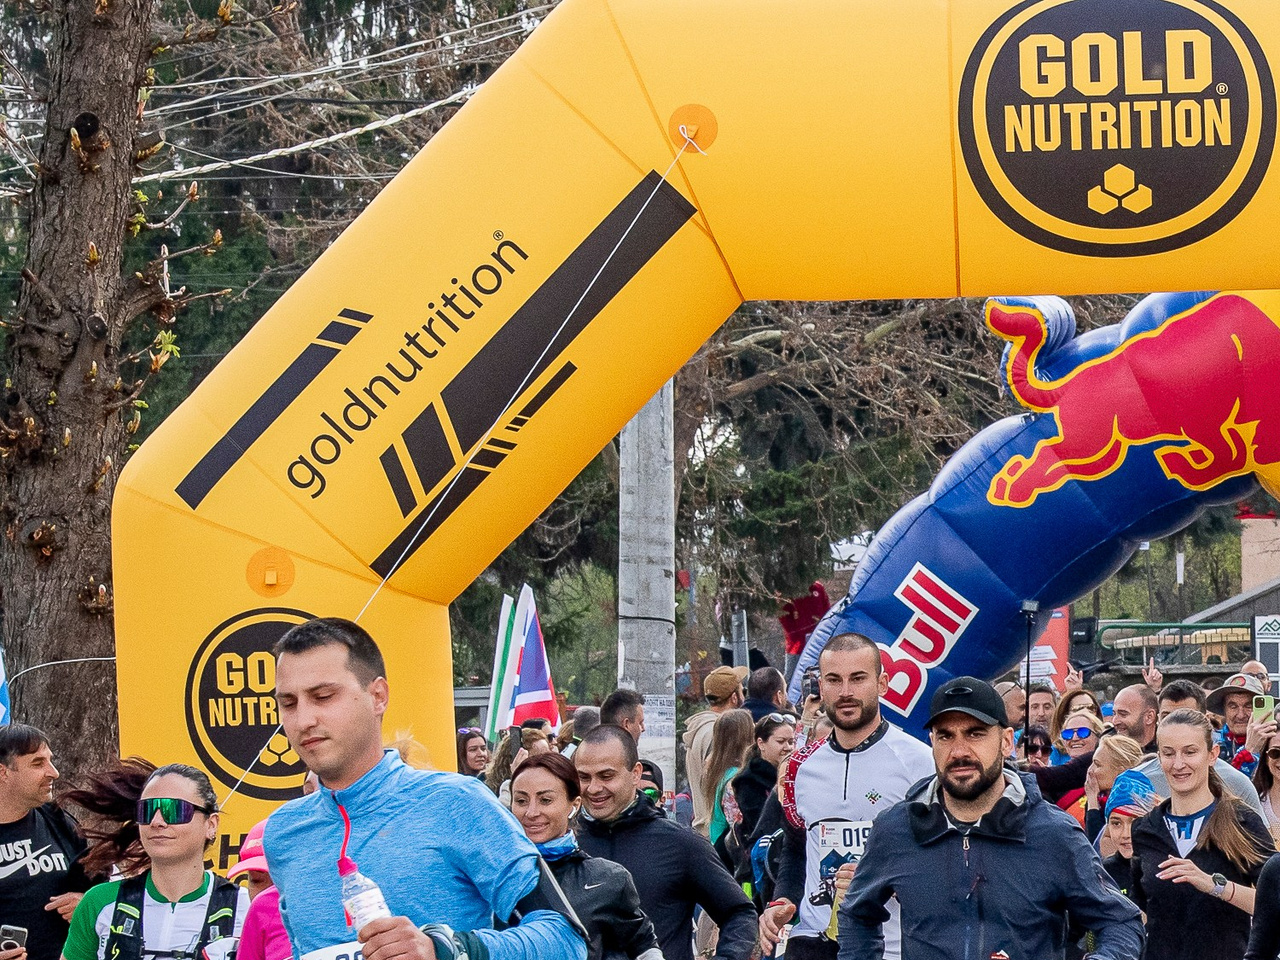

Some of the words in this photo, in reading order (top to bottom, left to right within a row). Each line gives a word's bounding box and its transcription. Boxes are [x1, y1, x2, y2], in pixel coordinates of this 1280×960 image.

[1004, 98, 1232, 153] NUTRITION
[878, 566, 976, 714] Bull
[216, 651, 276, 694] GO
[842, 827, 870, 848] 019
